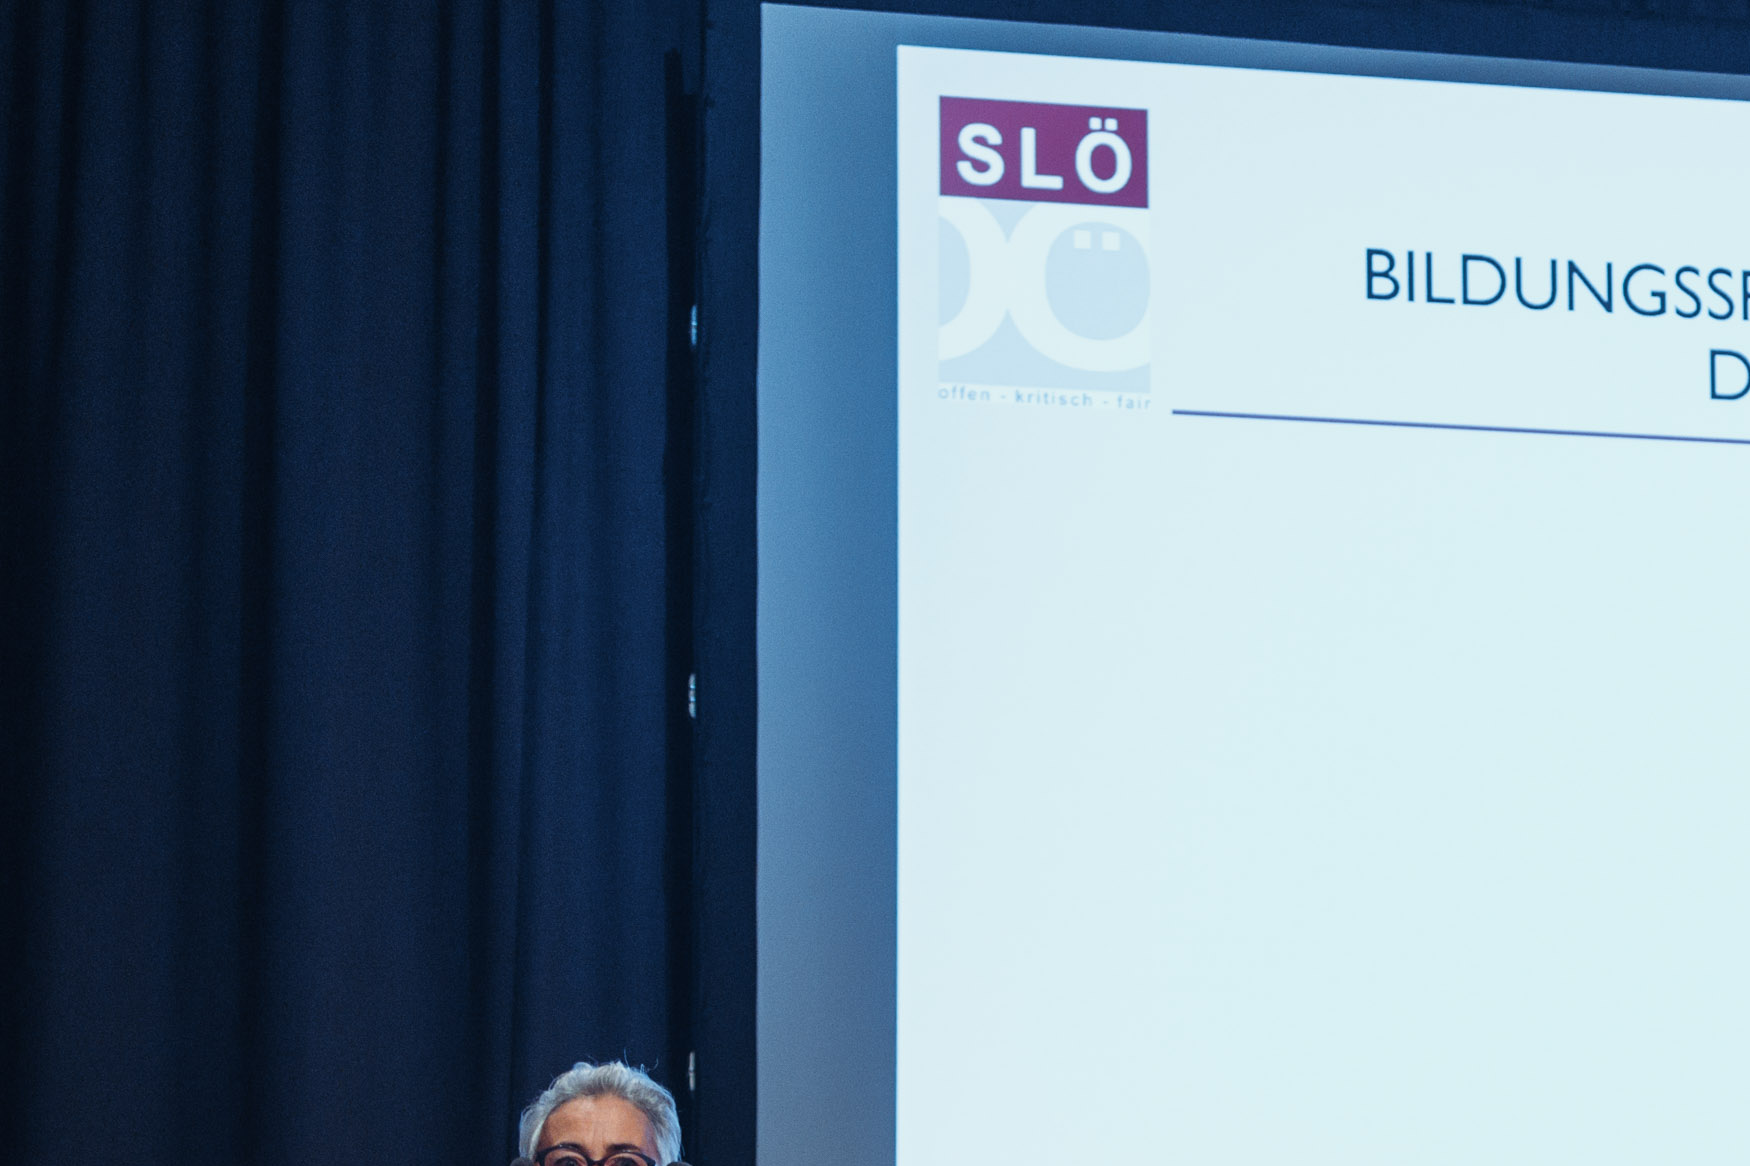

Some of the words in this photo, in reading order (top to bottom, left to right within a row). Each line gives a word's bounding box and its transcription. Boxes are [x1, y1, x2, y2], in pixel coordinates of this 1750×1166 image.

[956, 116, 1133, 195] SLÖ
[938, 386, 991, 401] offen
[1015, 390, 1093, 406] kritisch
[1117, 395, 1151, 409] fair
